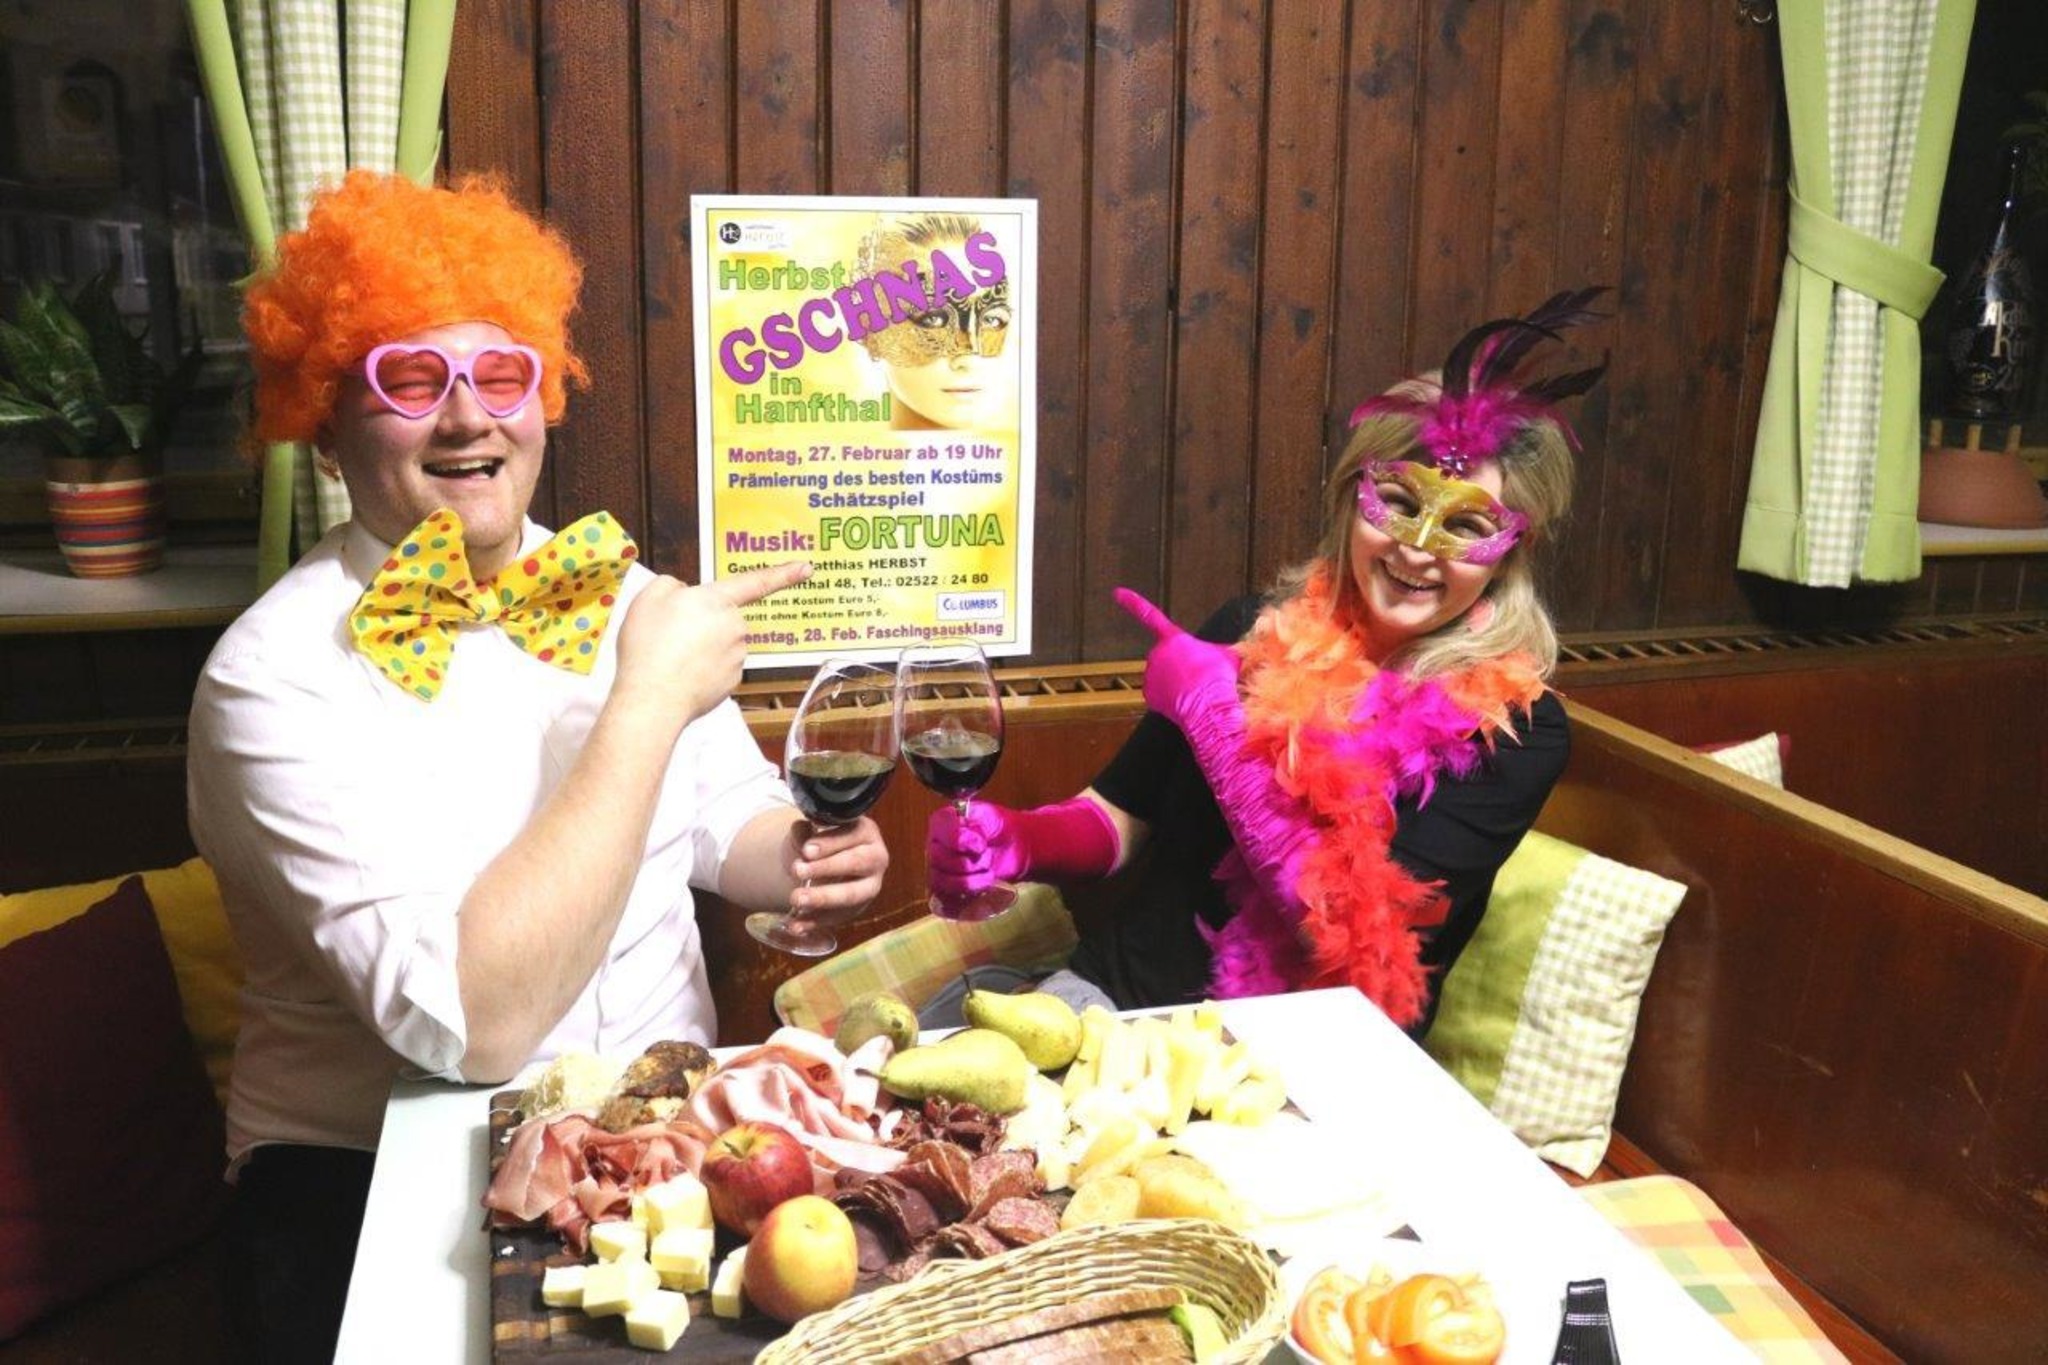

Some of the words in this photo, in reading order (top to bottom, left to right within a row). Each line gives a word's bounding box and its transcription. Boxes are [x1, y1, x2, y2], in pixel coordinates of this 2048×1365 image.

[719, 259, 846, 290] Herbst
[719, 231, 1007, 385] GSCHNAS
[769, 372, 802, 395] in
[735, 391, 891, 424] Hanfthal
[728, 447, 802, 466] Montag,
[809, 446, 836, 461] 27.
[842, 445, 912, 460] Februar
[917, 445, 939, 459] ab
[945, 444, 966, 459] 19
[971, 444, 1003, 459] Uhr
[728, 471, 828, 490] Prämierung
[833, 470, 864, 486] des
[868, 470, 926, 485] besten
[931, 468, 1003, 484] Kostüms
[808, 491, 924, 510] Schätzspiel
[726, 530, 815, 553] Musik:
[820, 513, 1005, 551] FORTUNA
[808, 560, 864, 571] atthias
[868, 558, 927, 569] HERBST
[861, 576, 892, 588] Tel.:
[895, 575, 939, 587] 02522
[951, 574, 967, 585] 24
[971, 573, 990, 584] 80
[771, 597, 789, 606] mit
[838, 595, 863, 605] Euro
[771, 611, 797, 620] ohne
[743, 629, 799, 645] enstag,
[804, 628, 826, 641] 28.
[831, 626, 862, 640] Feb.
[866, 622, 1004, 640] Faschingsausklang
